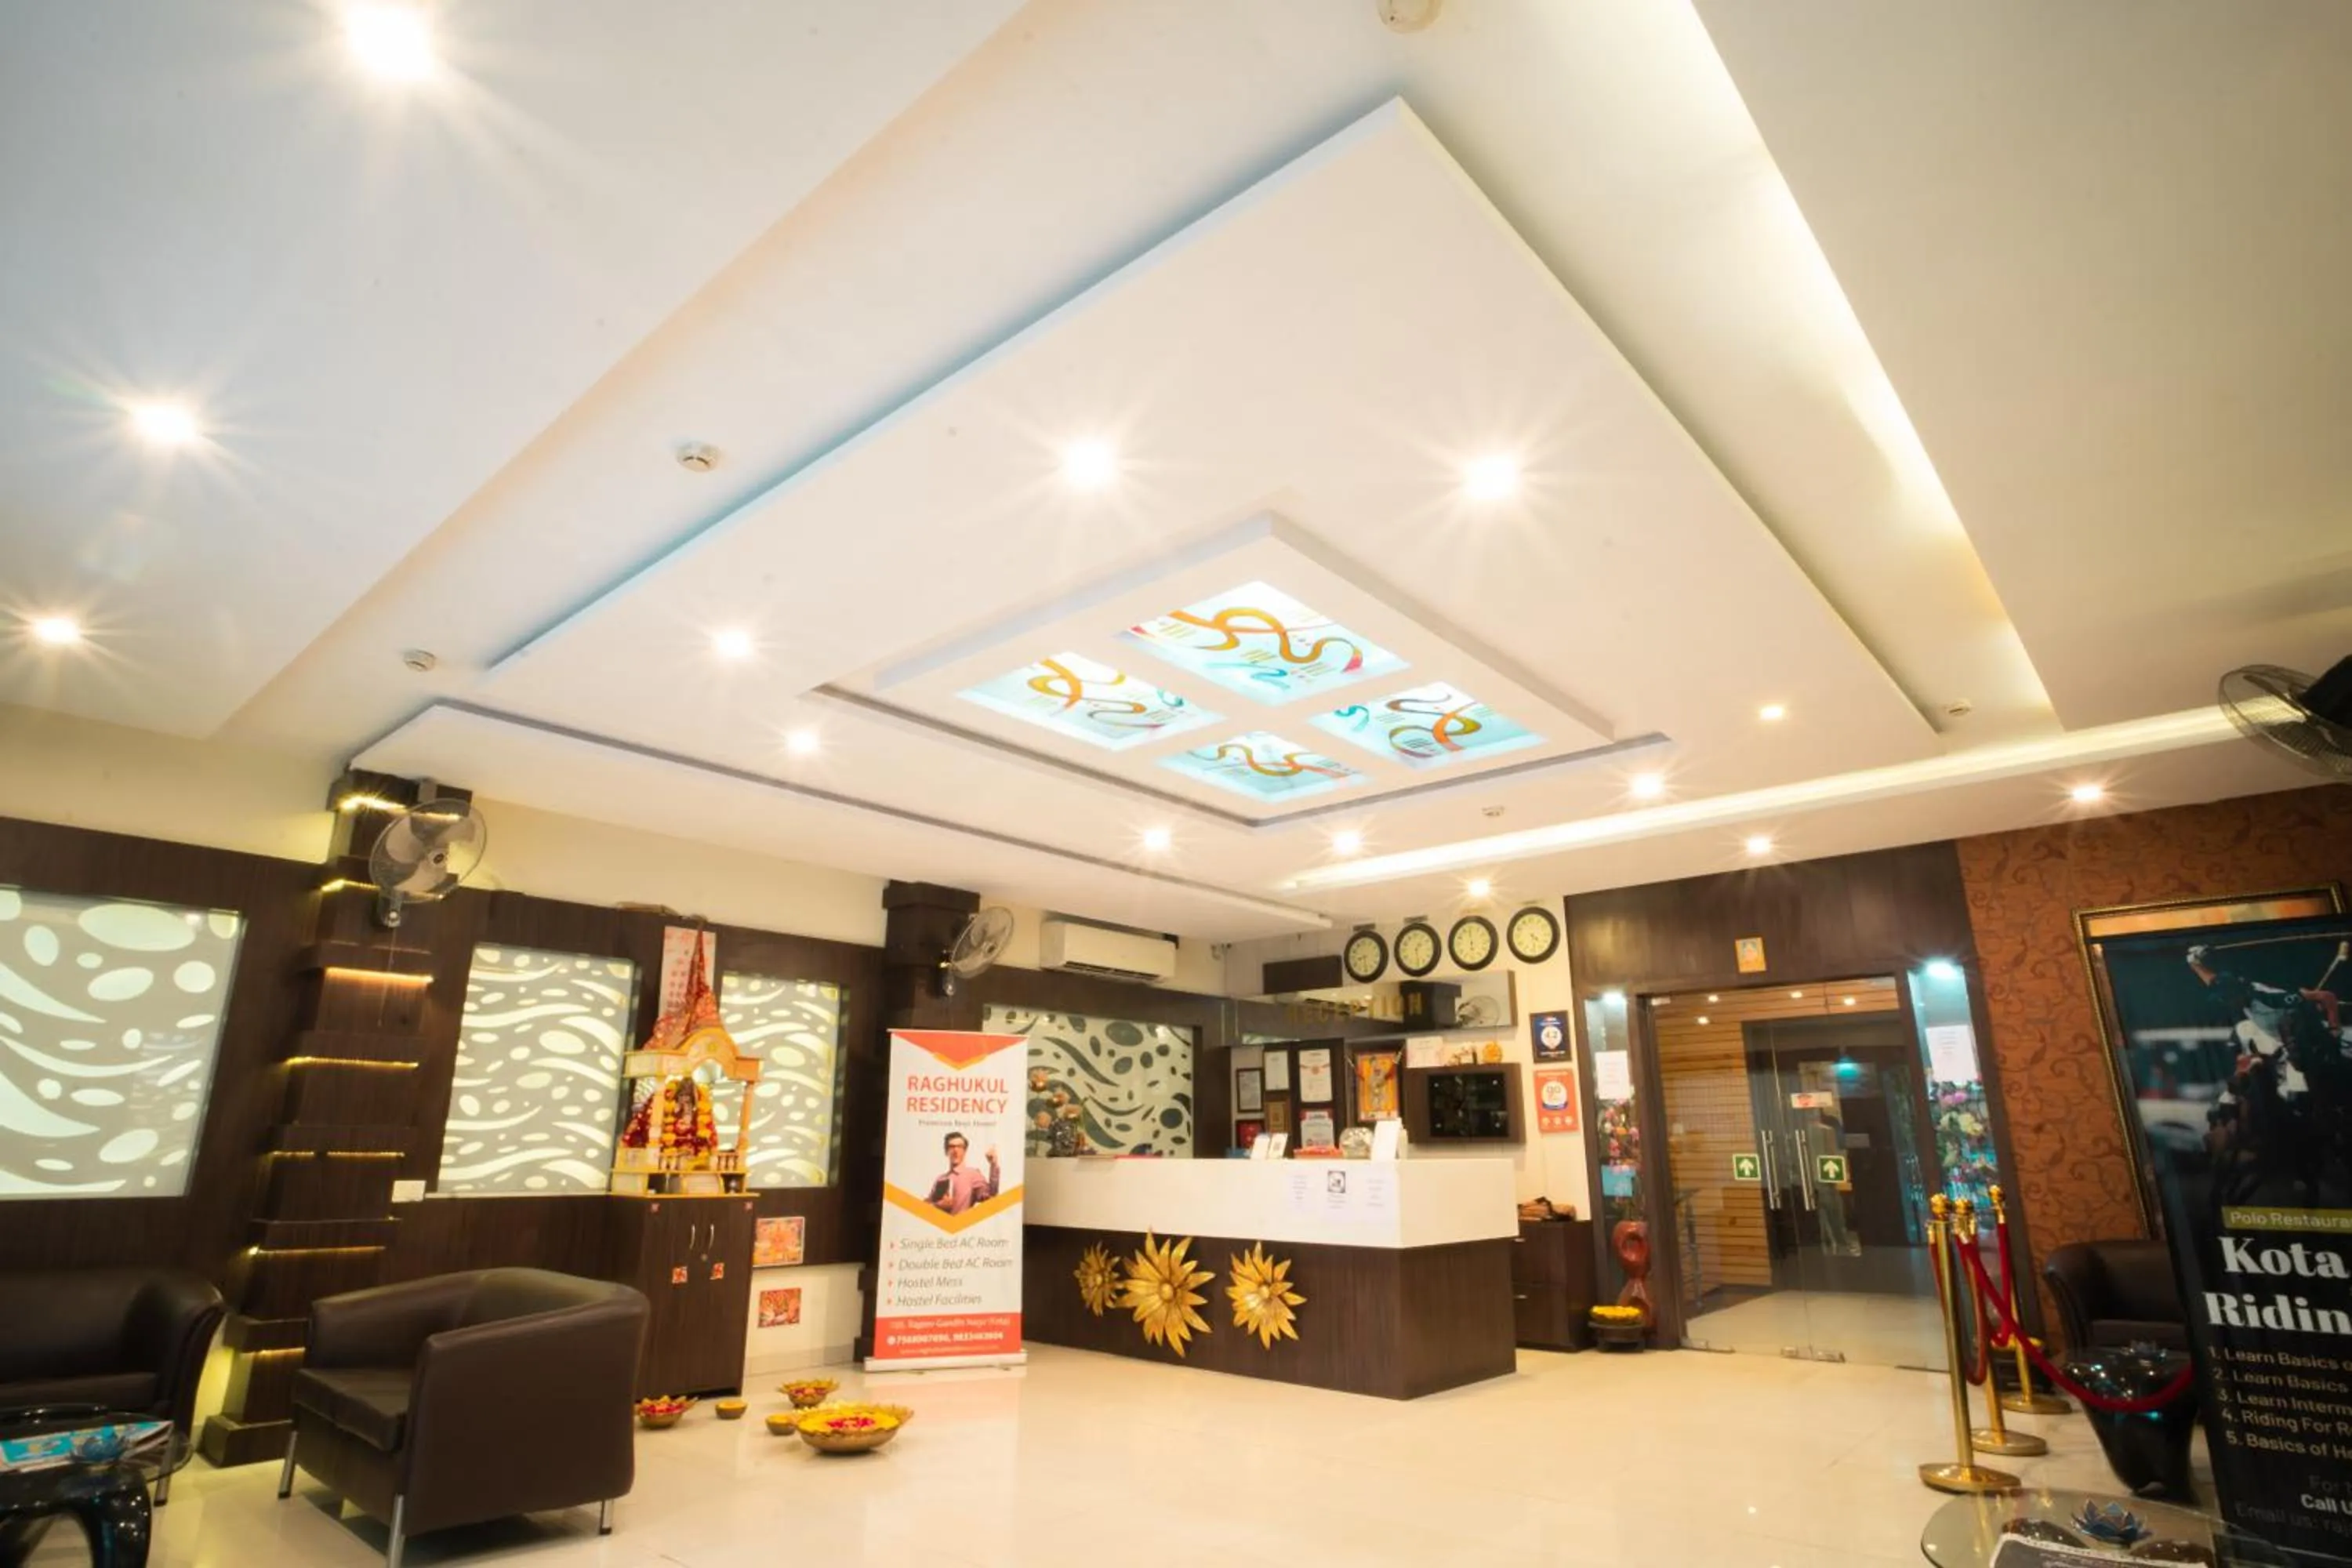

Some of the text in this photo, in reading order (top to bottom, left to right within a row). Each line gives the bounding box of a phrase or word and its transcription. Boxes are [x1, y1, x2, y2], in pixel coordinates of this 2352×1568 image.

[907, 1075, 1009, 1094] RAGHUKUL
[906, 1096, 1007, 1114] RESIDENCY
[2230, 1211, 2352, 1229] Polo Restaura
[900, 1237, 1009, 1252] Single Bed AC Room
[898, 1258, 1013, 1271] Double Bed AC Room
[2217, 1236, 2350, 1279] Kota
[897, 1276, 934, 1289] Hostel
[896, 1294, 933, 1306] Hostel
[2201, 1290, 2352, 1335] Ridin
[2208, 1345, 2221, 1359] 1.
[2224, 1346, 2274, 1363] Learn
[2278, 1351, 2339, 1370] Basics
[2212, 1367, 2349, 1393] 2. Learn Basics
[2218, 1388, 2233, 1402] 3.
[2237, 1390, 2288, 1409] Learn
[2222, 1408, 2238, 1423] 4.
[2241, 1409, 2298, 1432] Riding
[2302, 1416, 2332, 1433] For
[2226, 1429, 2244, 1446] 5.
[2245, 1432, 2307, 1454] Basics
[2310, 1442, 2328, 1457] of
[2301, 1494, 2338, 1514] Call
